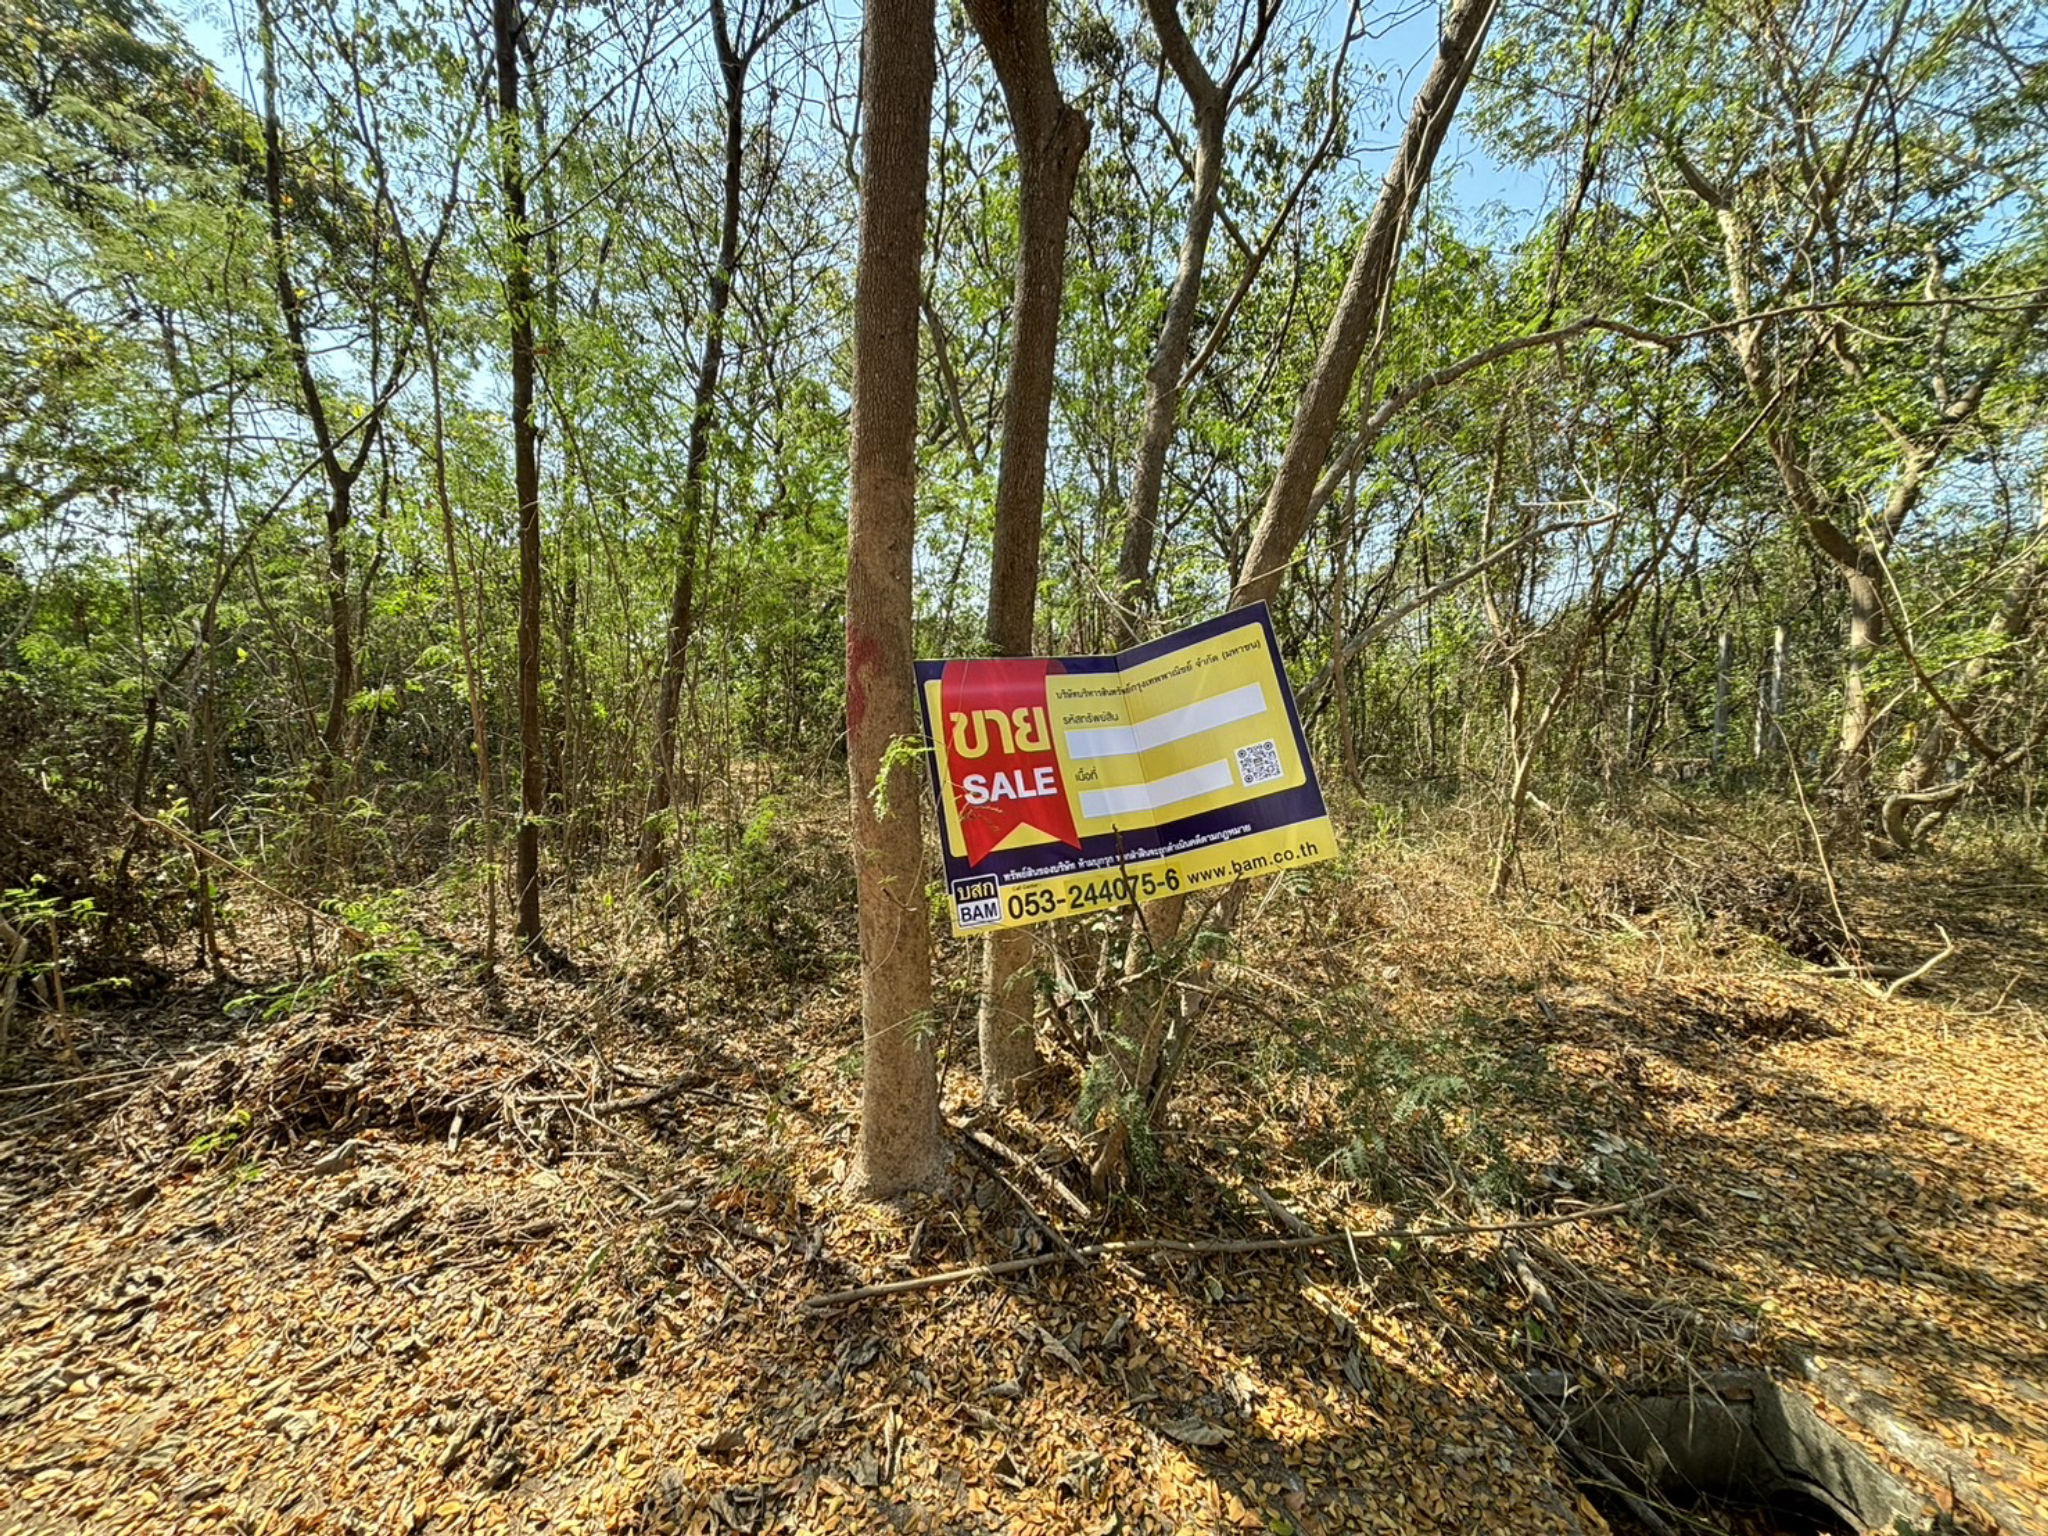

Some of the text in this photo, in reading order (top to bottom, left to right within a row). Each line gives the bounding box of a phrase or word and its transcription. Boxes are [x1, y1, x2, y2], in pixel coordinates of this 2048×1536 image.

[1195, 654, 1219, 667] จำกัด
[1221, 639, 1261, 660] (มหาชน)
[1063, 711, 1119, 725] รหัสทรัพย์สิน
[950, 706, 1051, 759] ขาย
[1075, 765, 1098, 781] เนื้อที่
[962, 766, 1058, 805] SALE
[956, 881, 996, 900] บสก
[1008, 841, 1318, 919] 053-244075-6 www.bam.co.th
[960, 902, 998, 922] BAM
